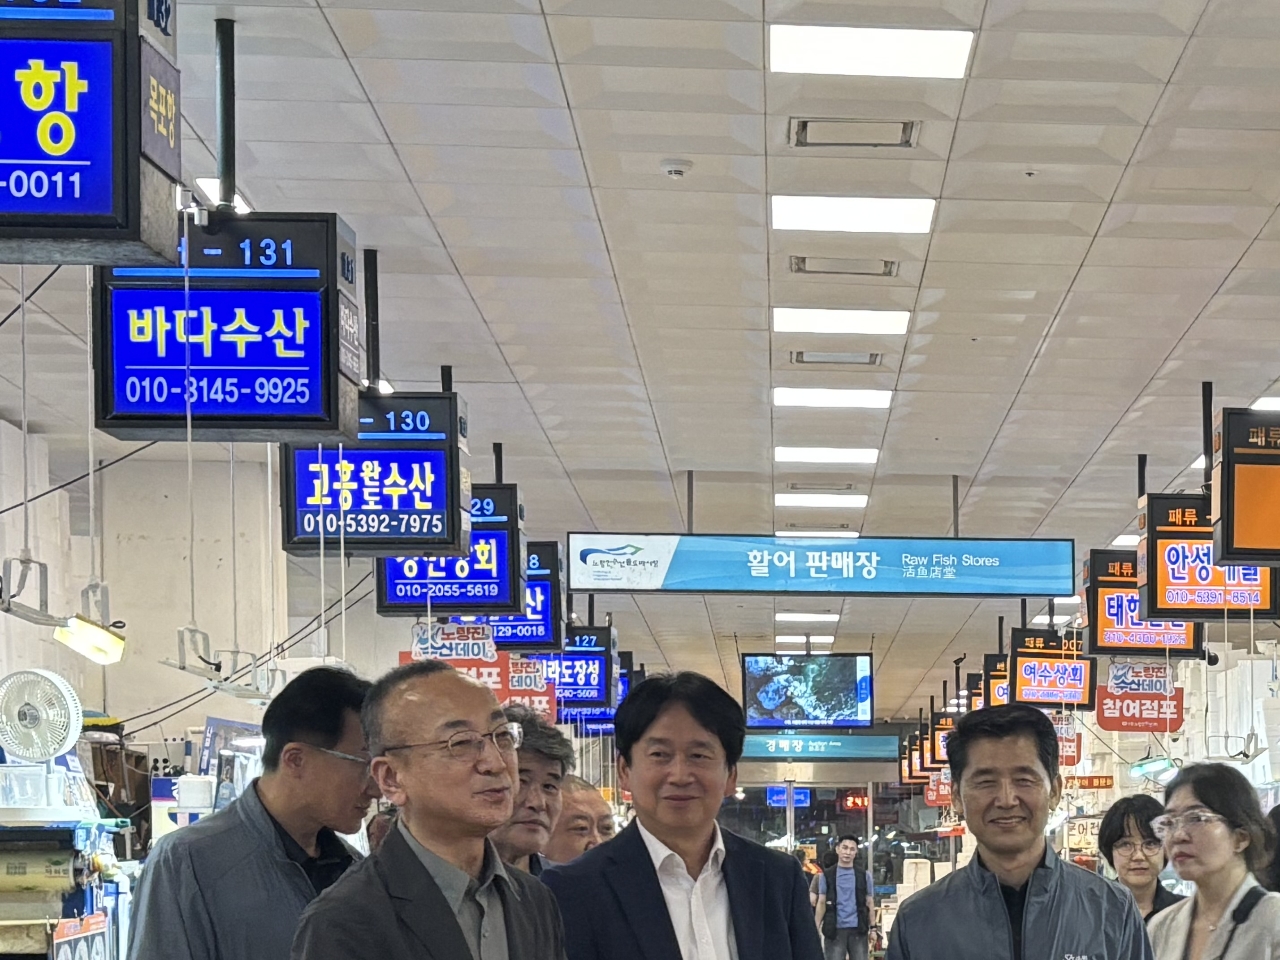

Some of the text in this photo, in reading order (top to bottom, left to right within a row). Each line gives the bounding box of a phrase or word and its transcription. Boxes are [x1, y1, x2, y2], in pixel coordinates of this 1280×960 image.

[149, 75, 176, 149] 목포항
[240, 238, 293, 266] 131
[126, 306, 310, 358] 바다수산
[125, 376, 310, 403] 010-3145-9925
[386, 411, 430, 430] 130
[303, 513, 443, 533] 010-5392-7975
[1168, 508, 1199, 526] 패류
[747, 550, 881, 580] 활어 판매장
[902, 554, 1000, 567] Raw Fish Stores
[396, 584, 499, 598] 010-2055-5619
[574, 635, 598, 647] 127
[1023, 662, 1084, 689] 여수상회
[1131, 666, 1167, 678] 노량진
[1102, 698, 1178, 719] 참여점포
